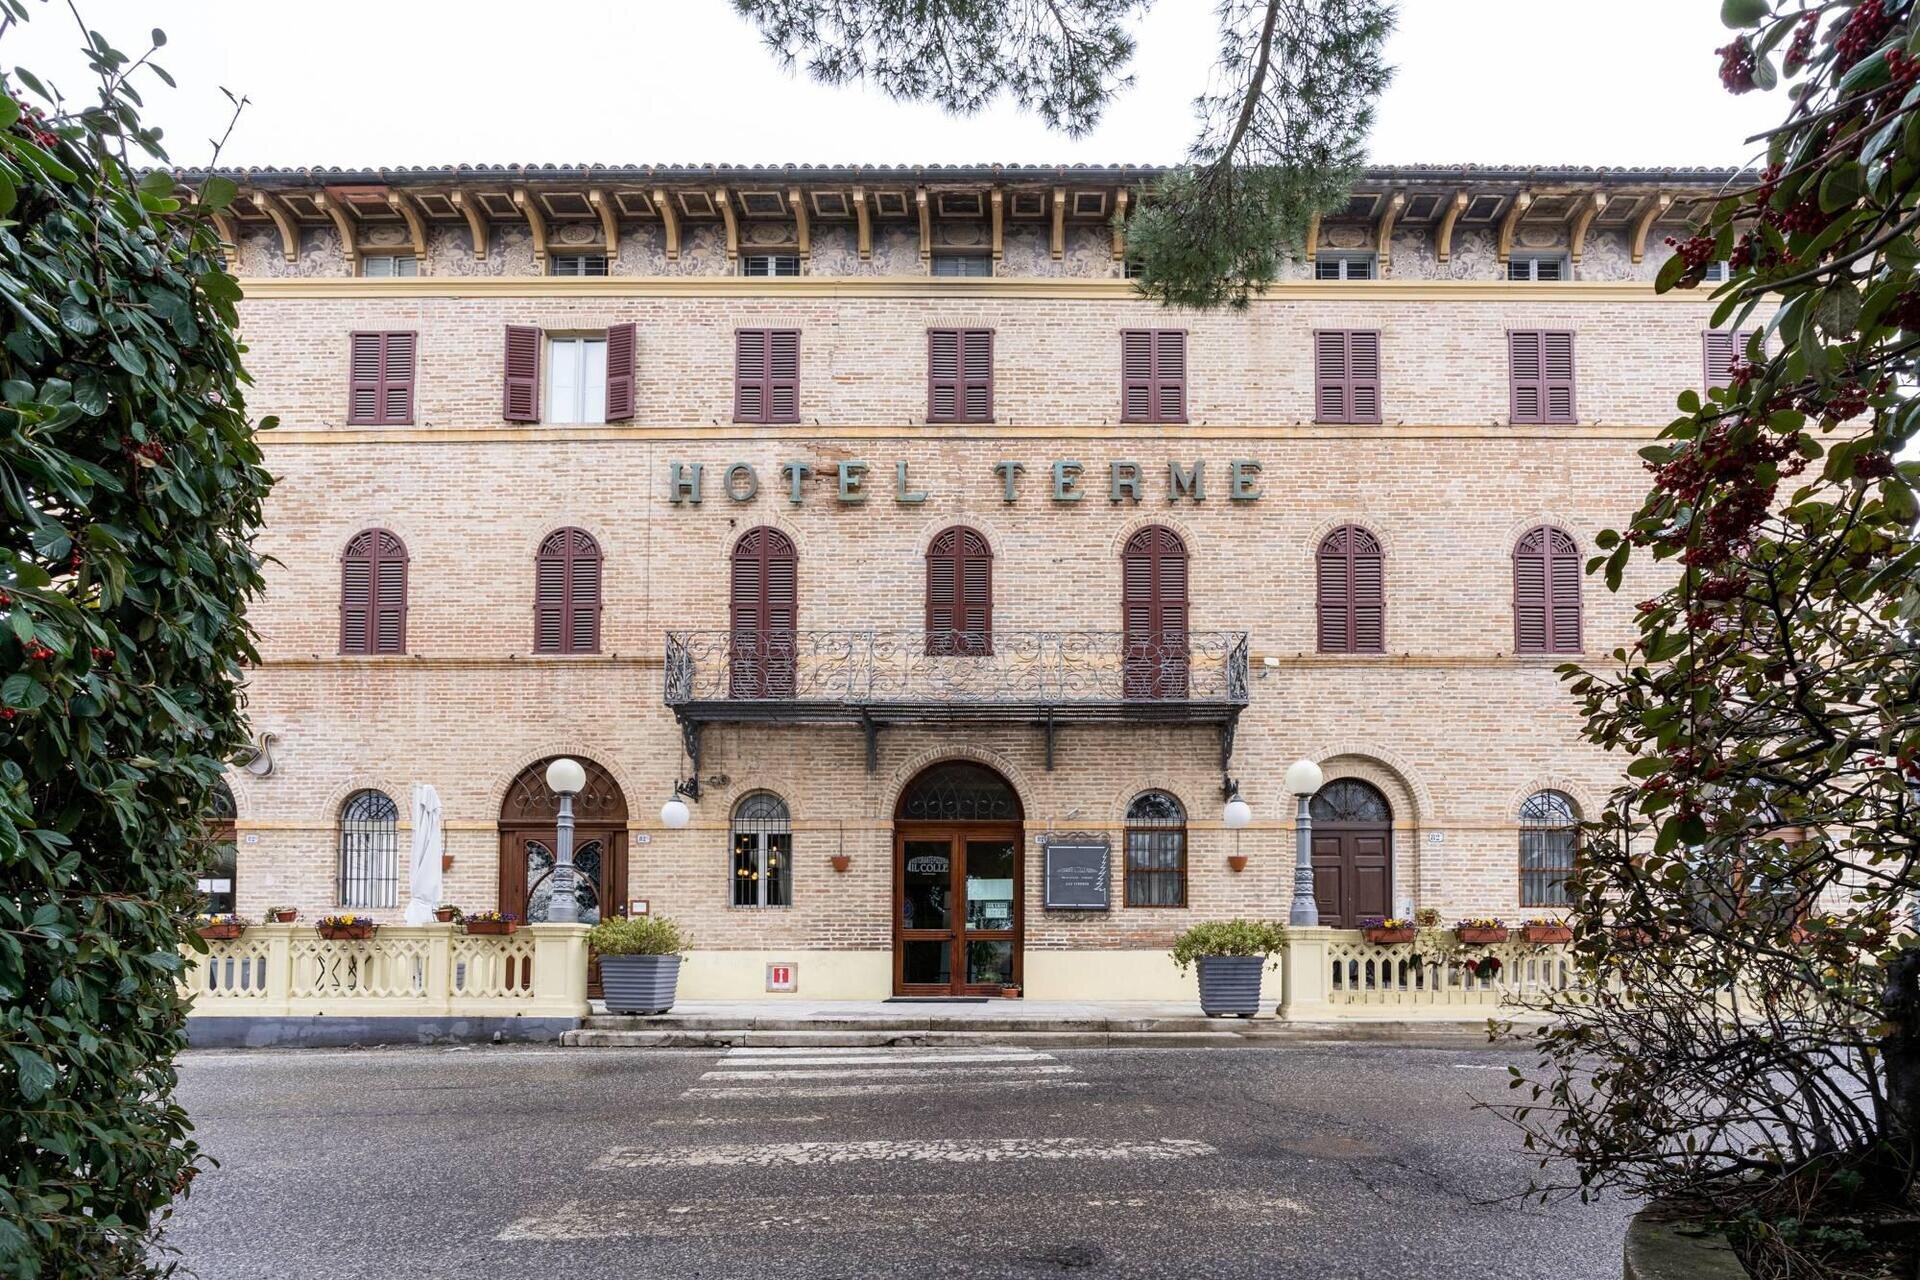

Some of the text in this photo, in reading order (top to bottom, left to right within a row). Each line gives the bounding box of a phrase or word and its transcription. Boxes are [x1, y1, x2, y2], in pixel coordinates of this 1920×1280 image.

[670, 459, 1263, 504] HOTEL TERME
[920, 863, 949, 873] COLLE
